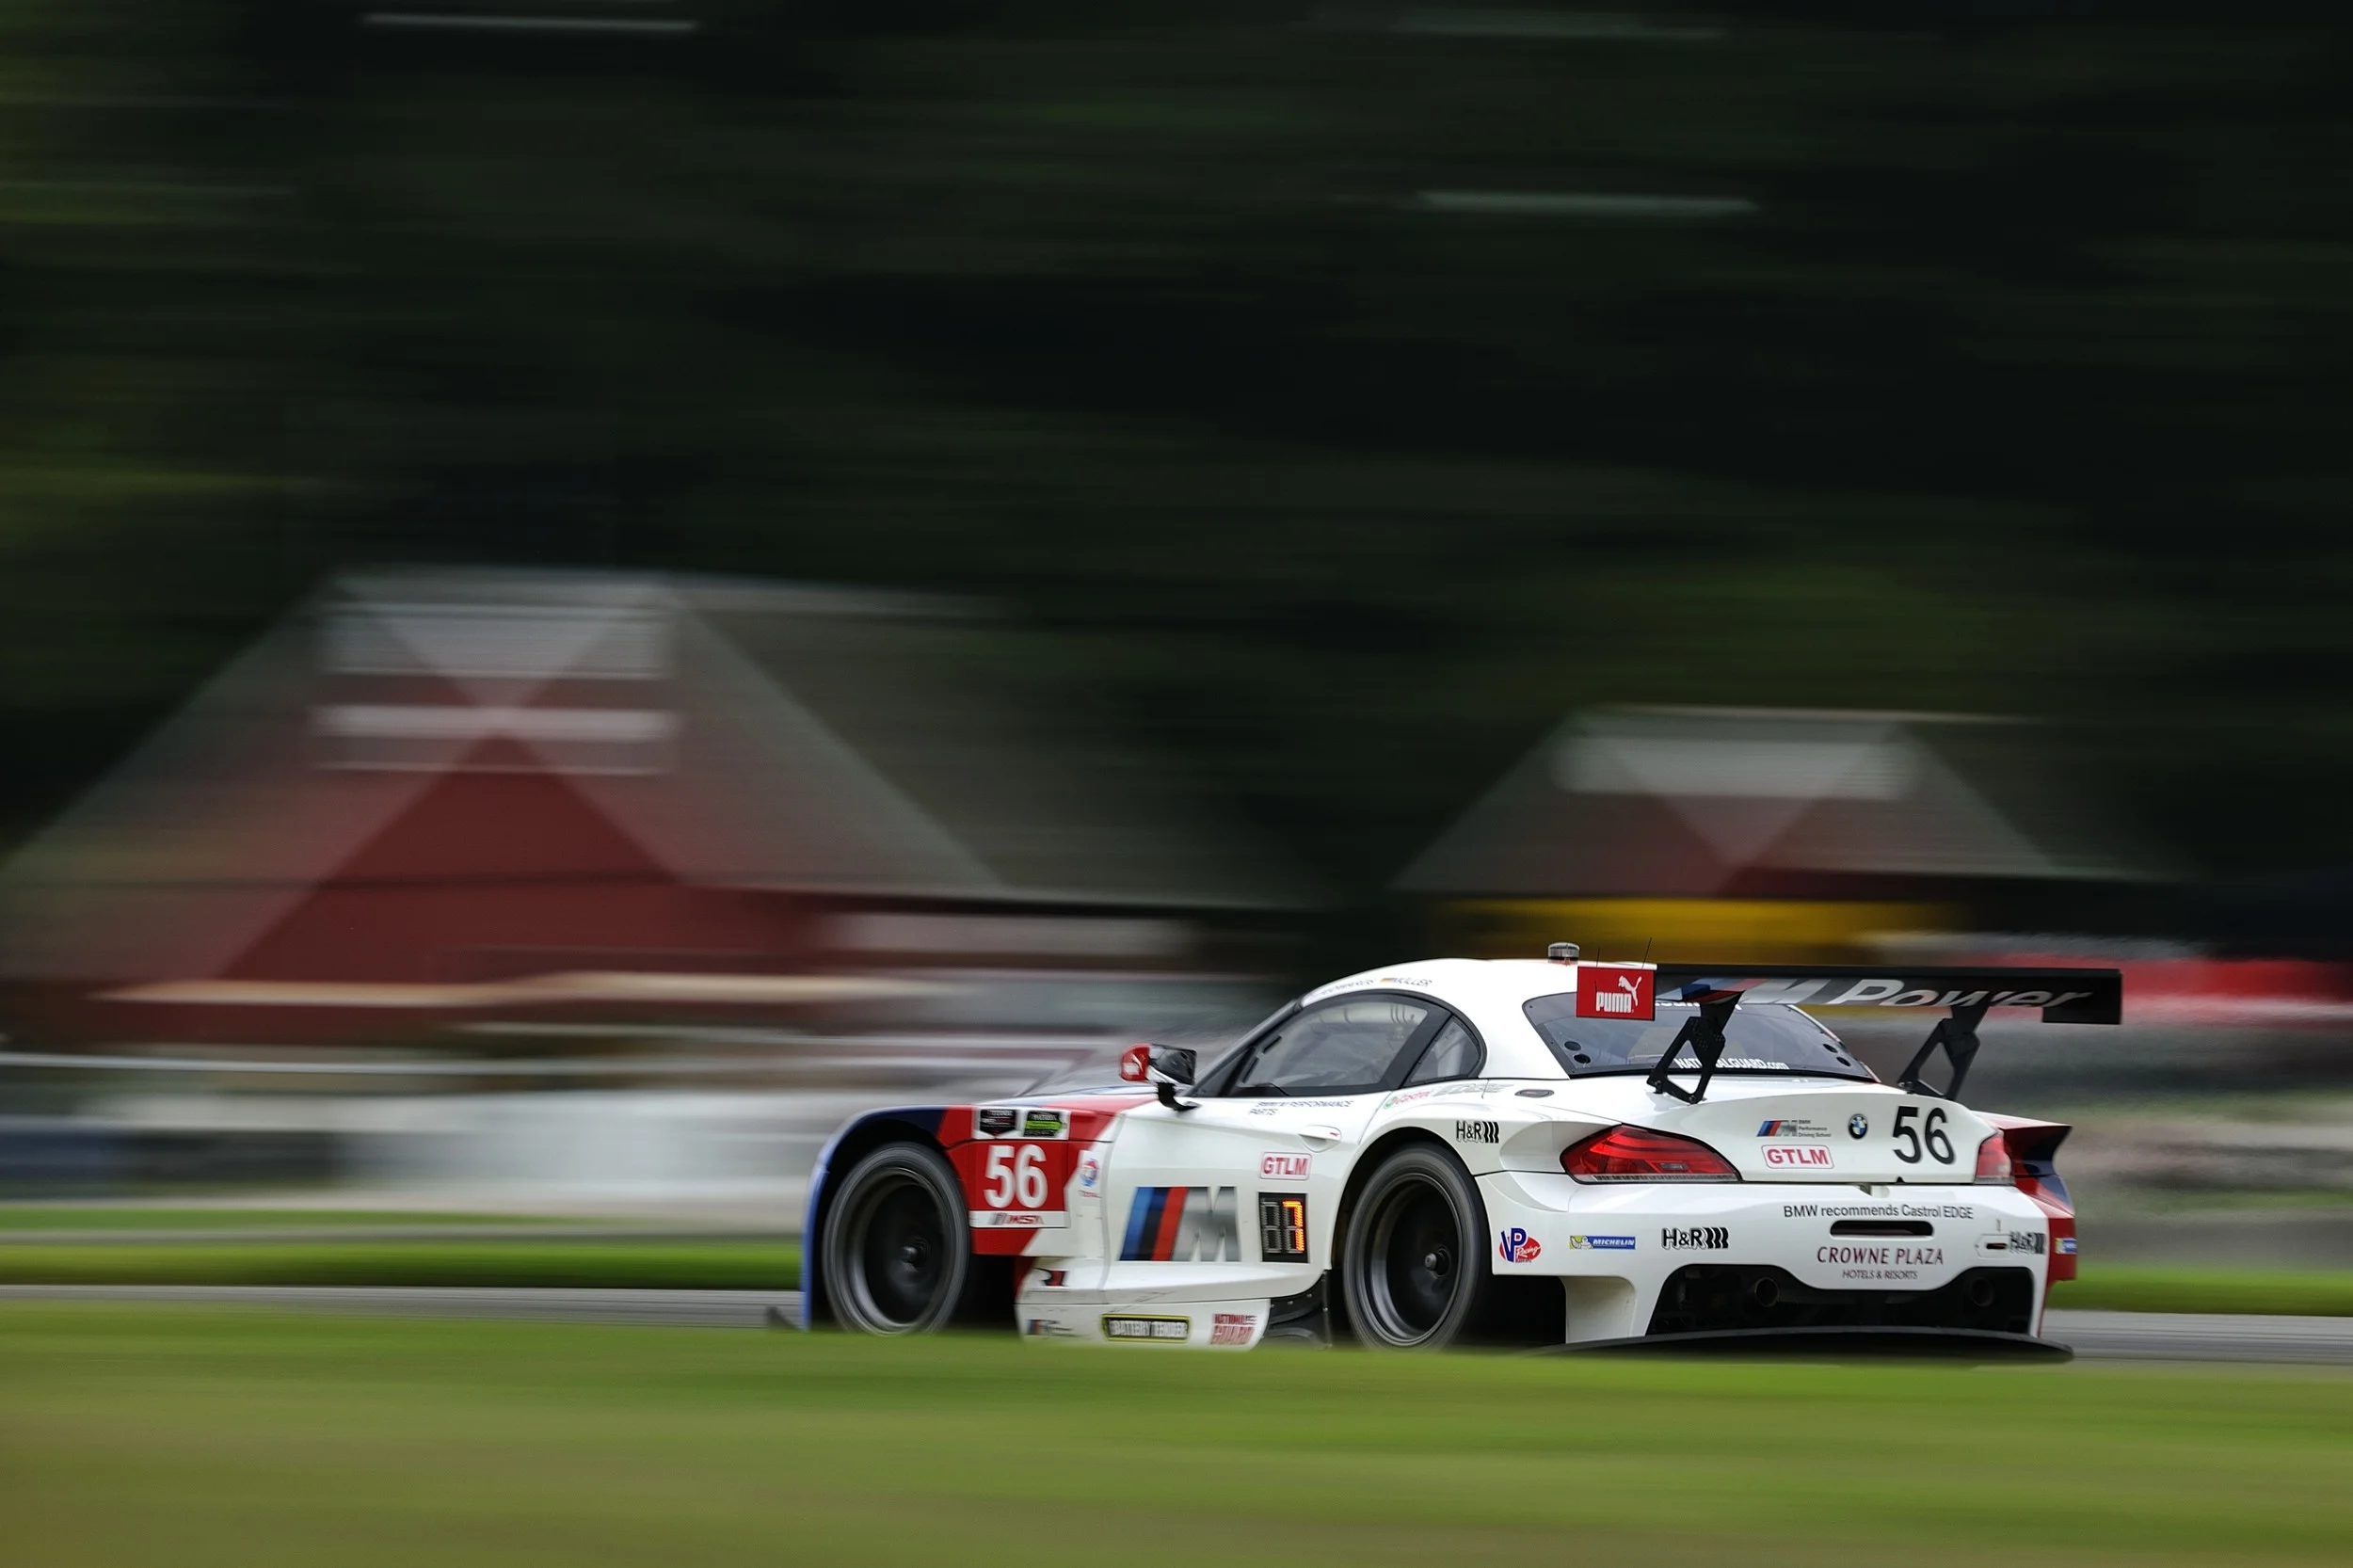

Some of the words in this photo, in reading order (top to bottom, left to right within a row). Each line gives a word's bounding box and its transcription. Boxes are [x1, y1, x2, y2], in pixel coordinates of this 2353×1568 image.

[1595, 991, 1632, 1014] PUMA
[1823, 978, 2093, 1007] Power
[1455, 1120, 1483, 1143] H&R
[1892, 1105, 1956, 1165] 56
[1264, 1157, 1309, 1176] GTLM
[1767, 1149, 1829, 1165] GTLM
[983, 1144, 1048, 1208] 56
[1784, 1205, 1818, 1218] BMW
[1820, 1204, 1899, 1217] recommends
[1901, 1204, 1942, 1218] Castrol
[1944, 1206, 1975, 1220] EDGE
[1500, 1227, 1527, 1263] VP
[1661, 1227, 1705, 1250] H&R
[1817, 1246, 1891, 1265] CROWNE
[1896, 1248, 1944, 1266] PLAZA
[1842, 1270, 1876, 1280] HOTELS
[1884, 1271, 1919, 1281] RESORTS
